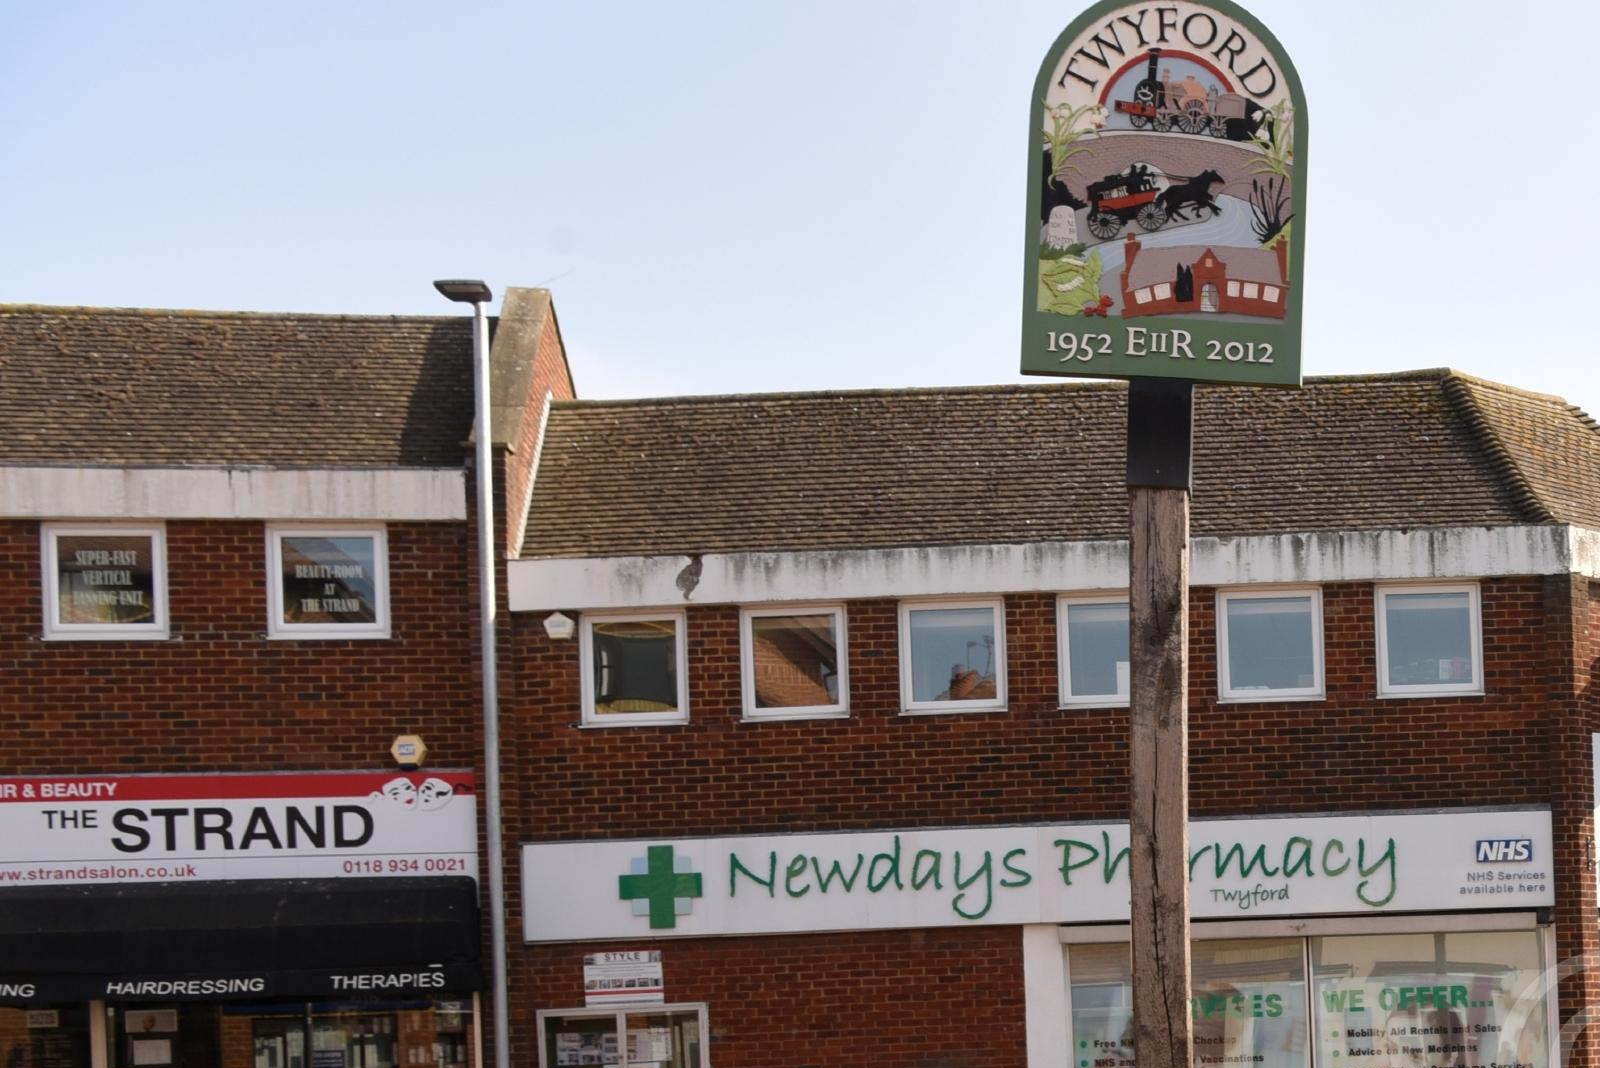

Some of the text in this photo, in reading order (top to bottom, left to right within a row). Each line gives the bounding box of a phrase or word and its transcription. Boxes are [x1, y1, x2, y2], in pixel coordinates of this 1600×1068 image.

[1057, 7, 1277, 100] TWYFORD
[1047, 330, 1113, 363] 1952
[1206, 340, 1275, 364] 2012
[82, 570, 133, 585] VERTICAL
[323, 583, 336, 596] AT
[301, 598, 360, 612] THE STRAND
[22, 783, 36, 798] &
[41, 782, 117, 798] BEAUTY
[42, 804, 374, 853] THE STRAND
[1477, 840, 1531, 861] NHS
[343, 860, 383, 874] 0118
[388, 859, 419, 872] 934
[425, 858, 466, 871] 0021
[729, 830, 1399, 920] Newdays Phrmacy
[1467, 870, 1546, 881] NHS Services
[1209, 883, 1290, 910] Twyford
[1459, 883, 1547, 895] available here
[604, 951, 641, 961] STYLE
[106, 977, 265, 995] HAIRDRESSING
[331, 971, 446, 990] THERAPIES
[1323, 985, 1495, 1013] WE OFFER...
[1347, 1027, 1386, 1038] Mobility
[1390, 1026, 1406, 1036] Aid
[1410, 1025, 1448, 1035] Rentals
[1474, 1023, 1502, 1033] Sales
[1094, 1039, 1135, 1048] Free NH
[1348, 1047, 1382, 1056] Advice
[1427, 1044, 1478, 1054] Medicines
[1200, 1055, 1264, 1063] Vaccinations
